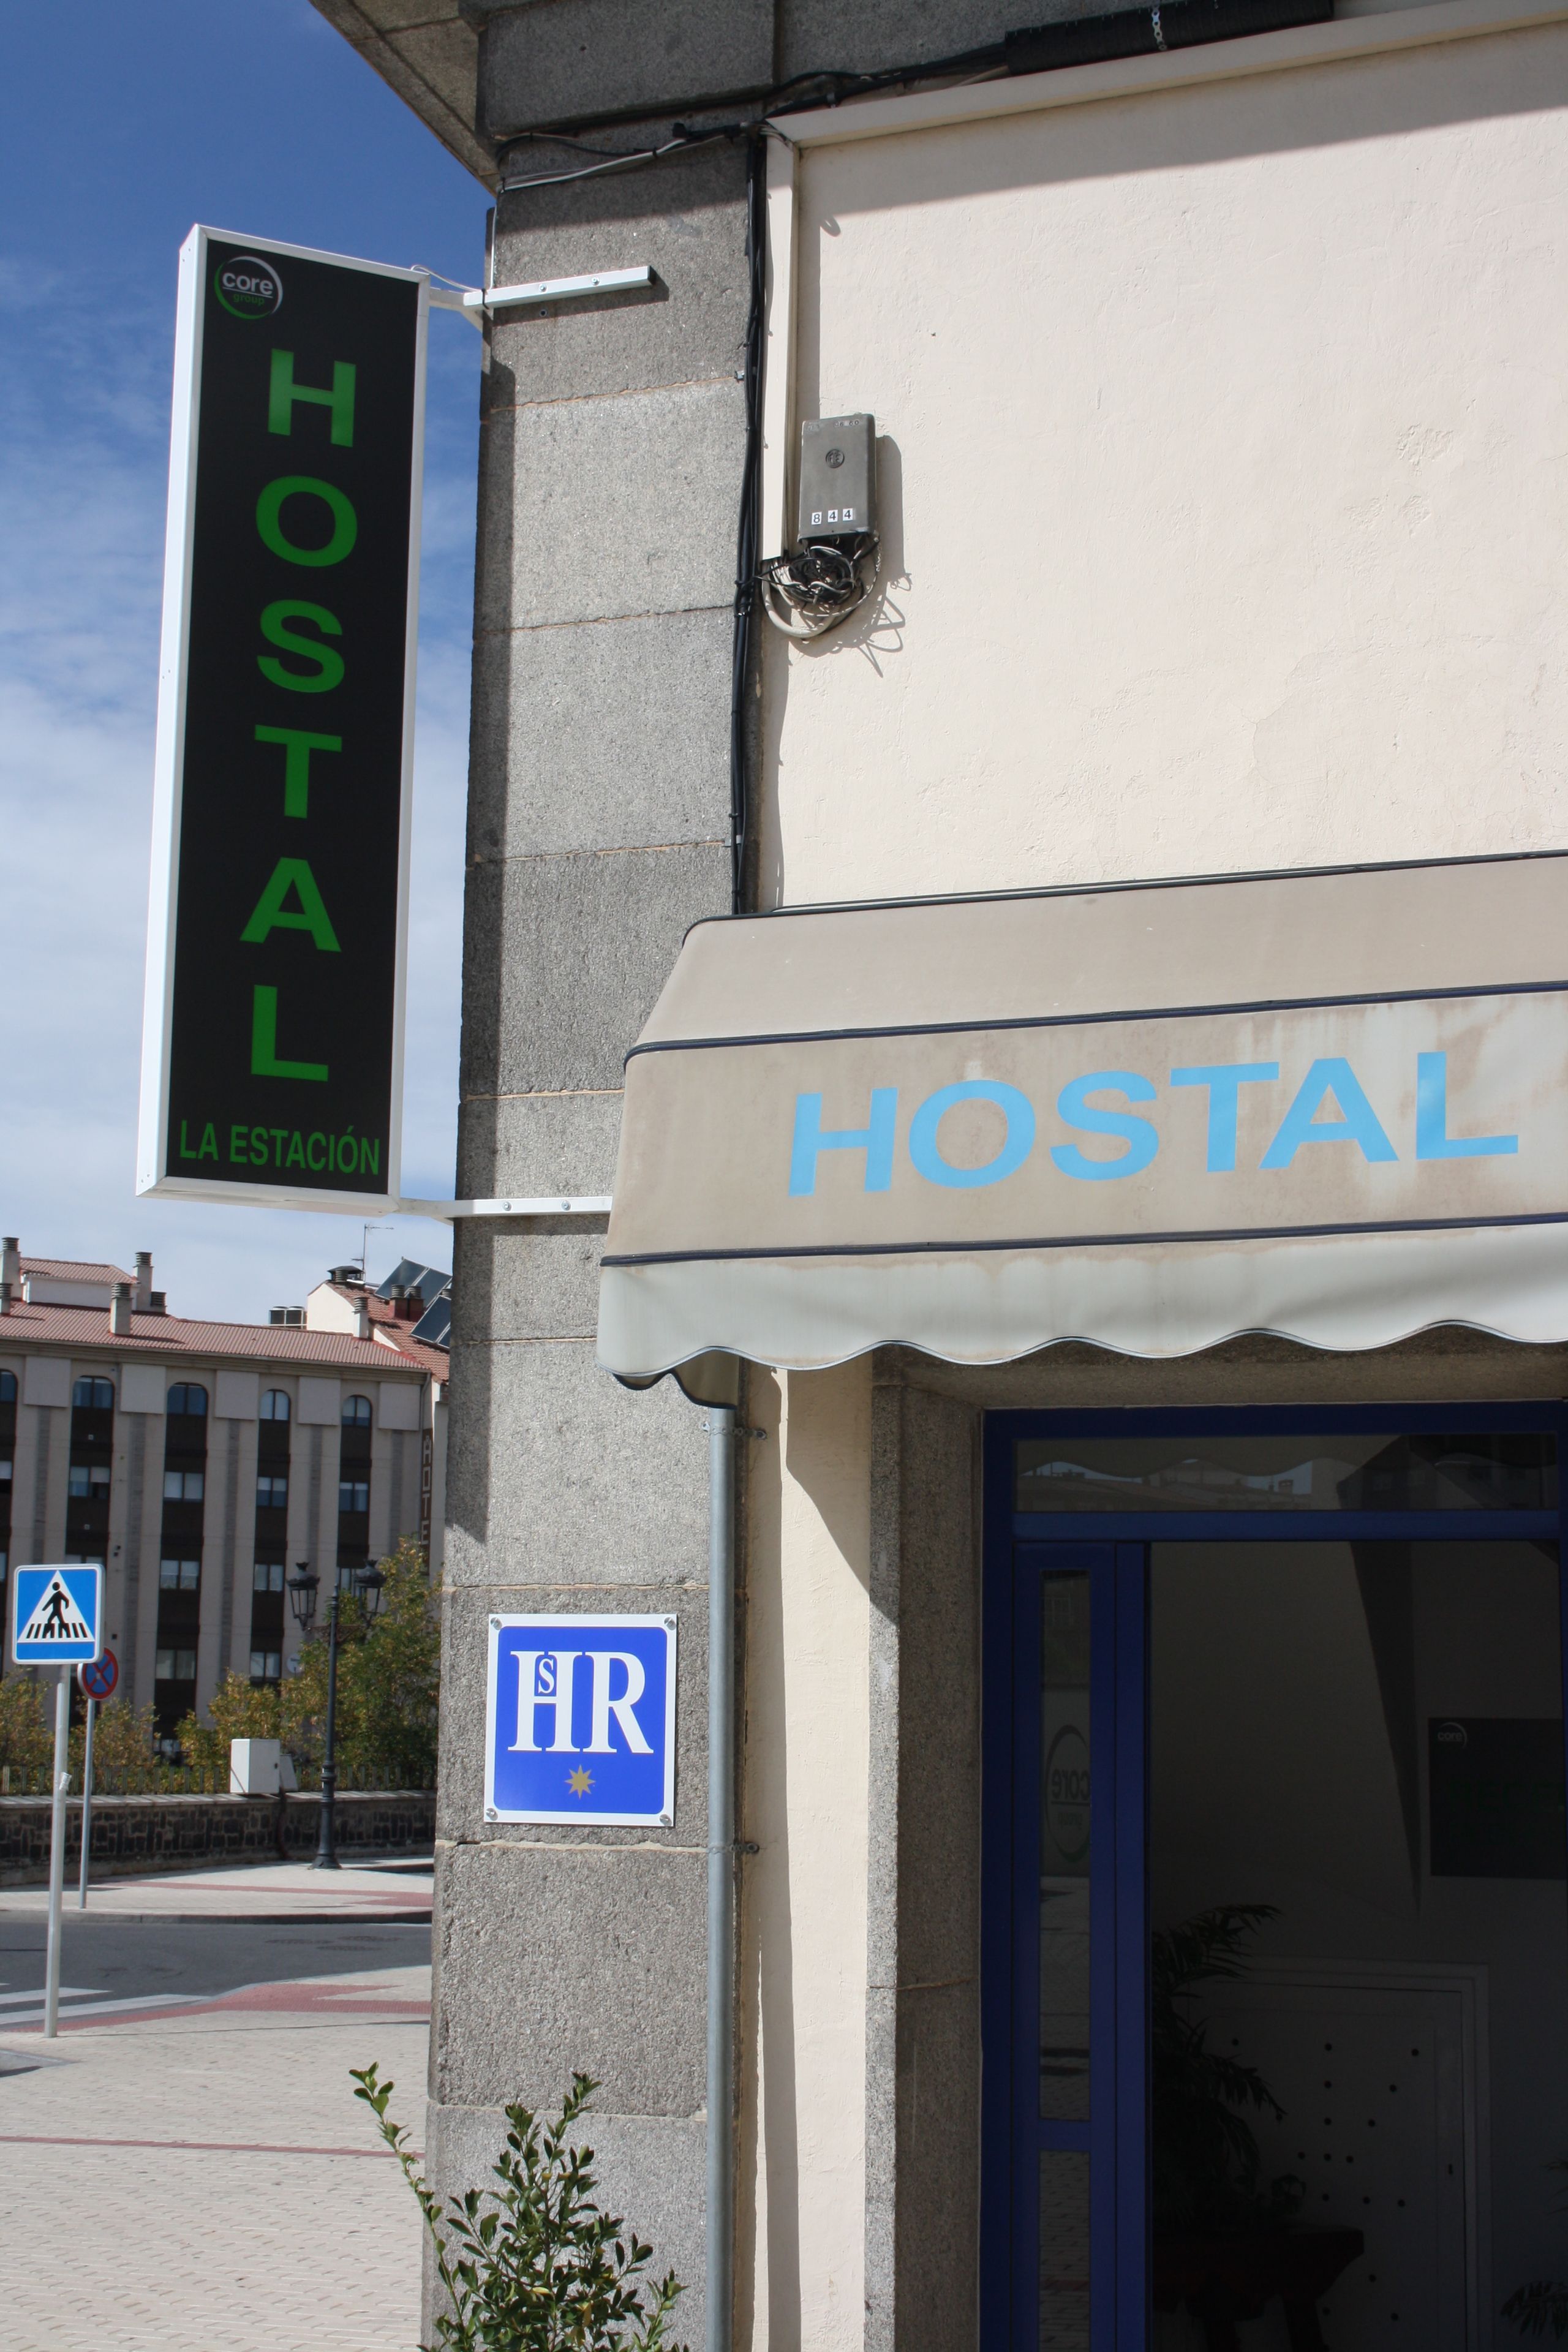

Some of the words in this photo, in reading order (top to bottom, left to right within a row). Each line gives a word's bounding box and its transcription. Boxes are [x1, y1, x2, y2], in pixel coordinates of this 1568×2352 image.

[222, 271, 274, 295] core
[233, 293, 265, 306] group
[239, 348, 358, 1082] HOSTAL
[788, 1050, 1518, 1197] HOSTAL
[179, 1120, 218, 1161] LA
[229, 1125, 380, 1176] ESTACIÓN
[1437, 1731, 1462, 1741] core
